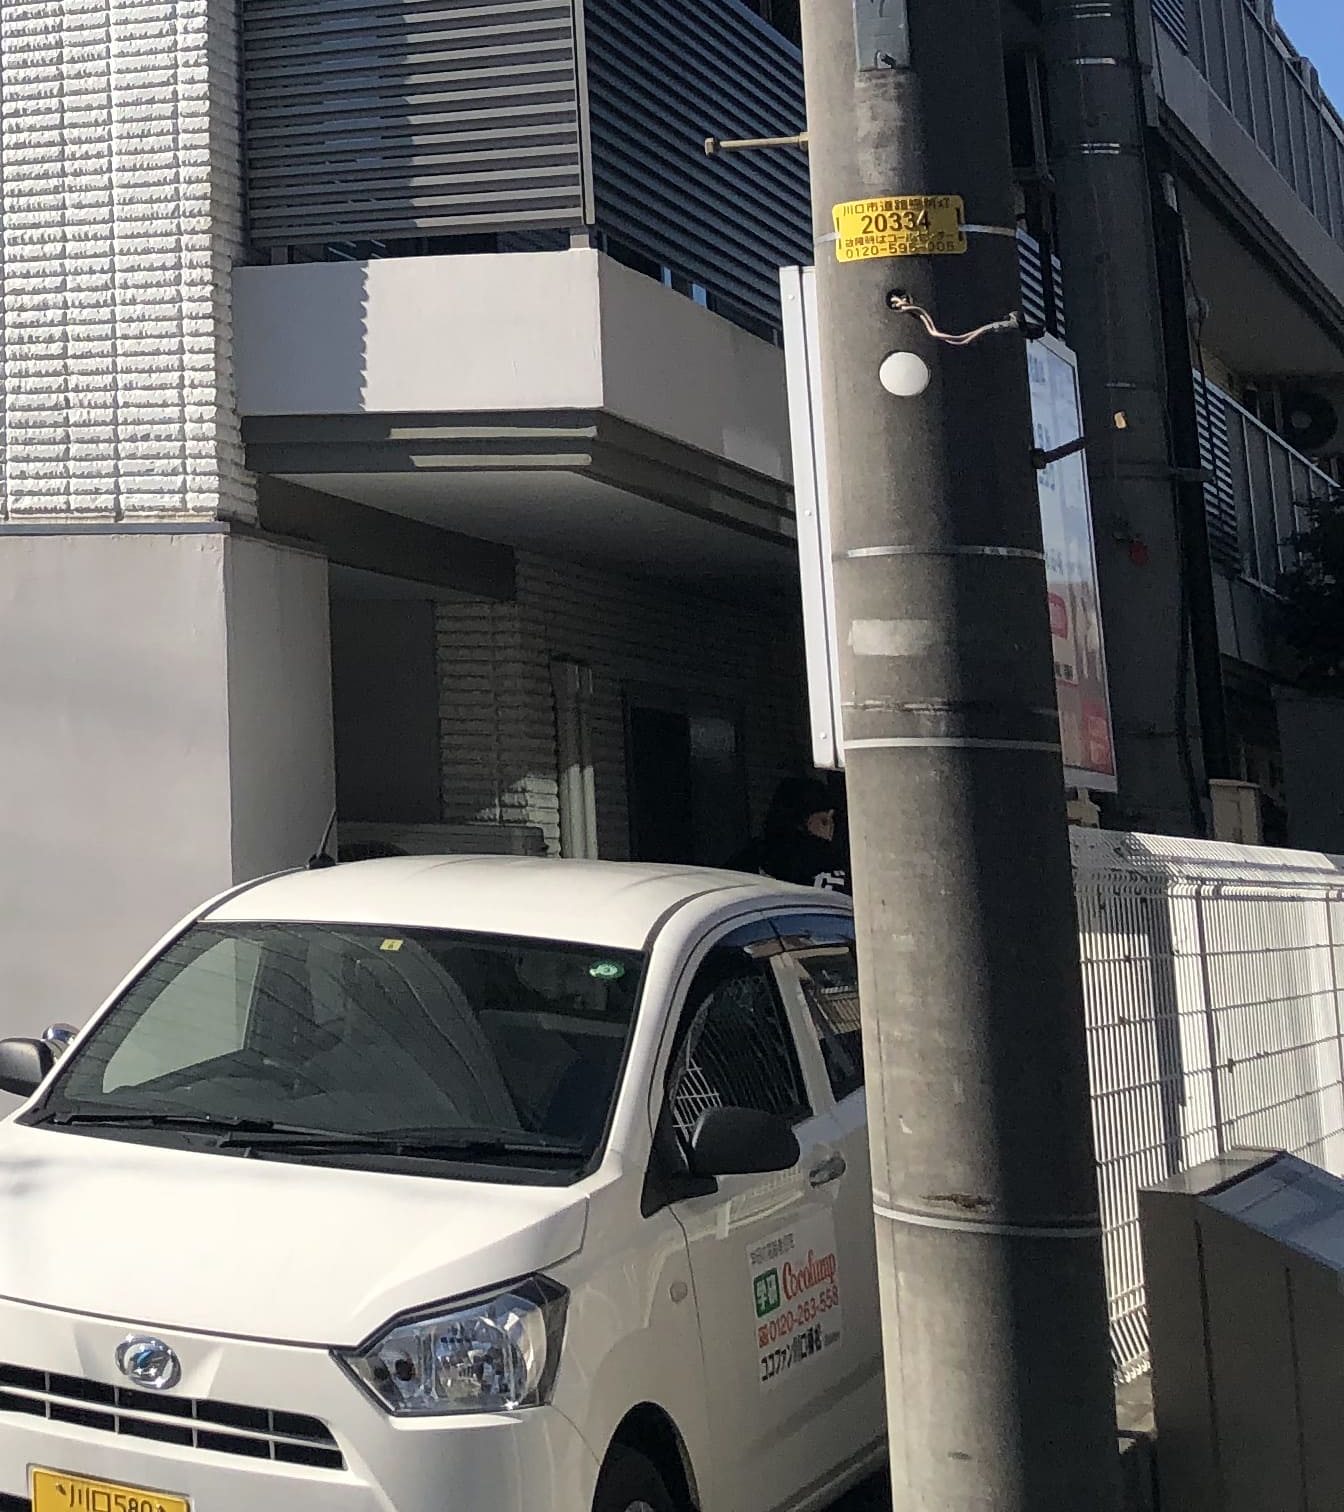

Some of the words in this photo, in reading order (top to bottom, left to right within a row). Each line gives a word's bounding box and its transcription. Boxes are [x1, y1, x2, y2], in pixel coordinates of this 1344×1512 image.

[861, 211, 931, 234] 20334
[782, 1249, 837, 1300] Cocofump
[769, 1285, 839, 1343] 0120-263-558
